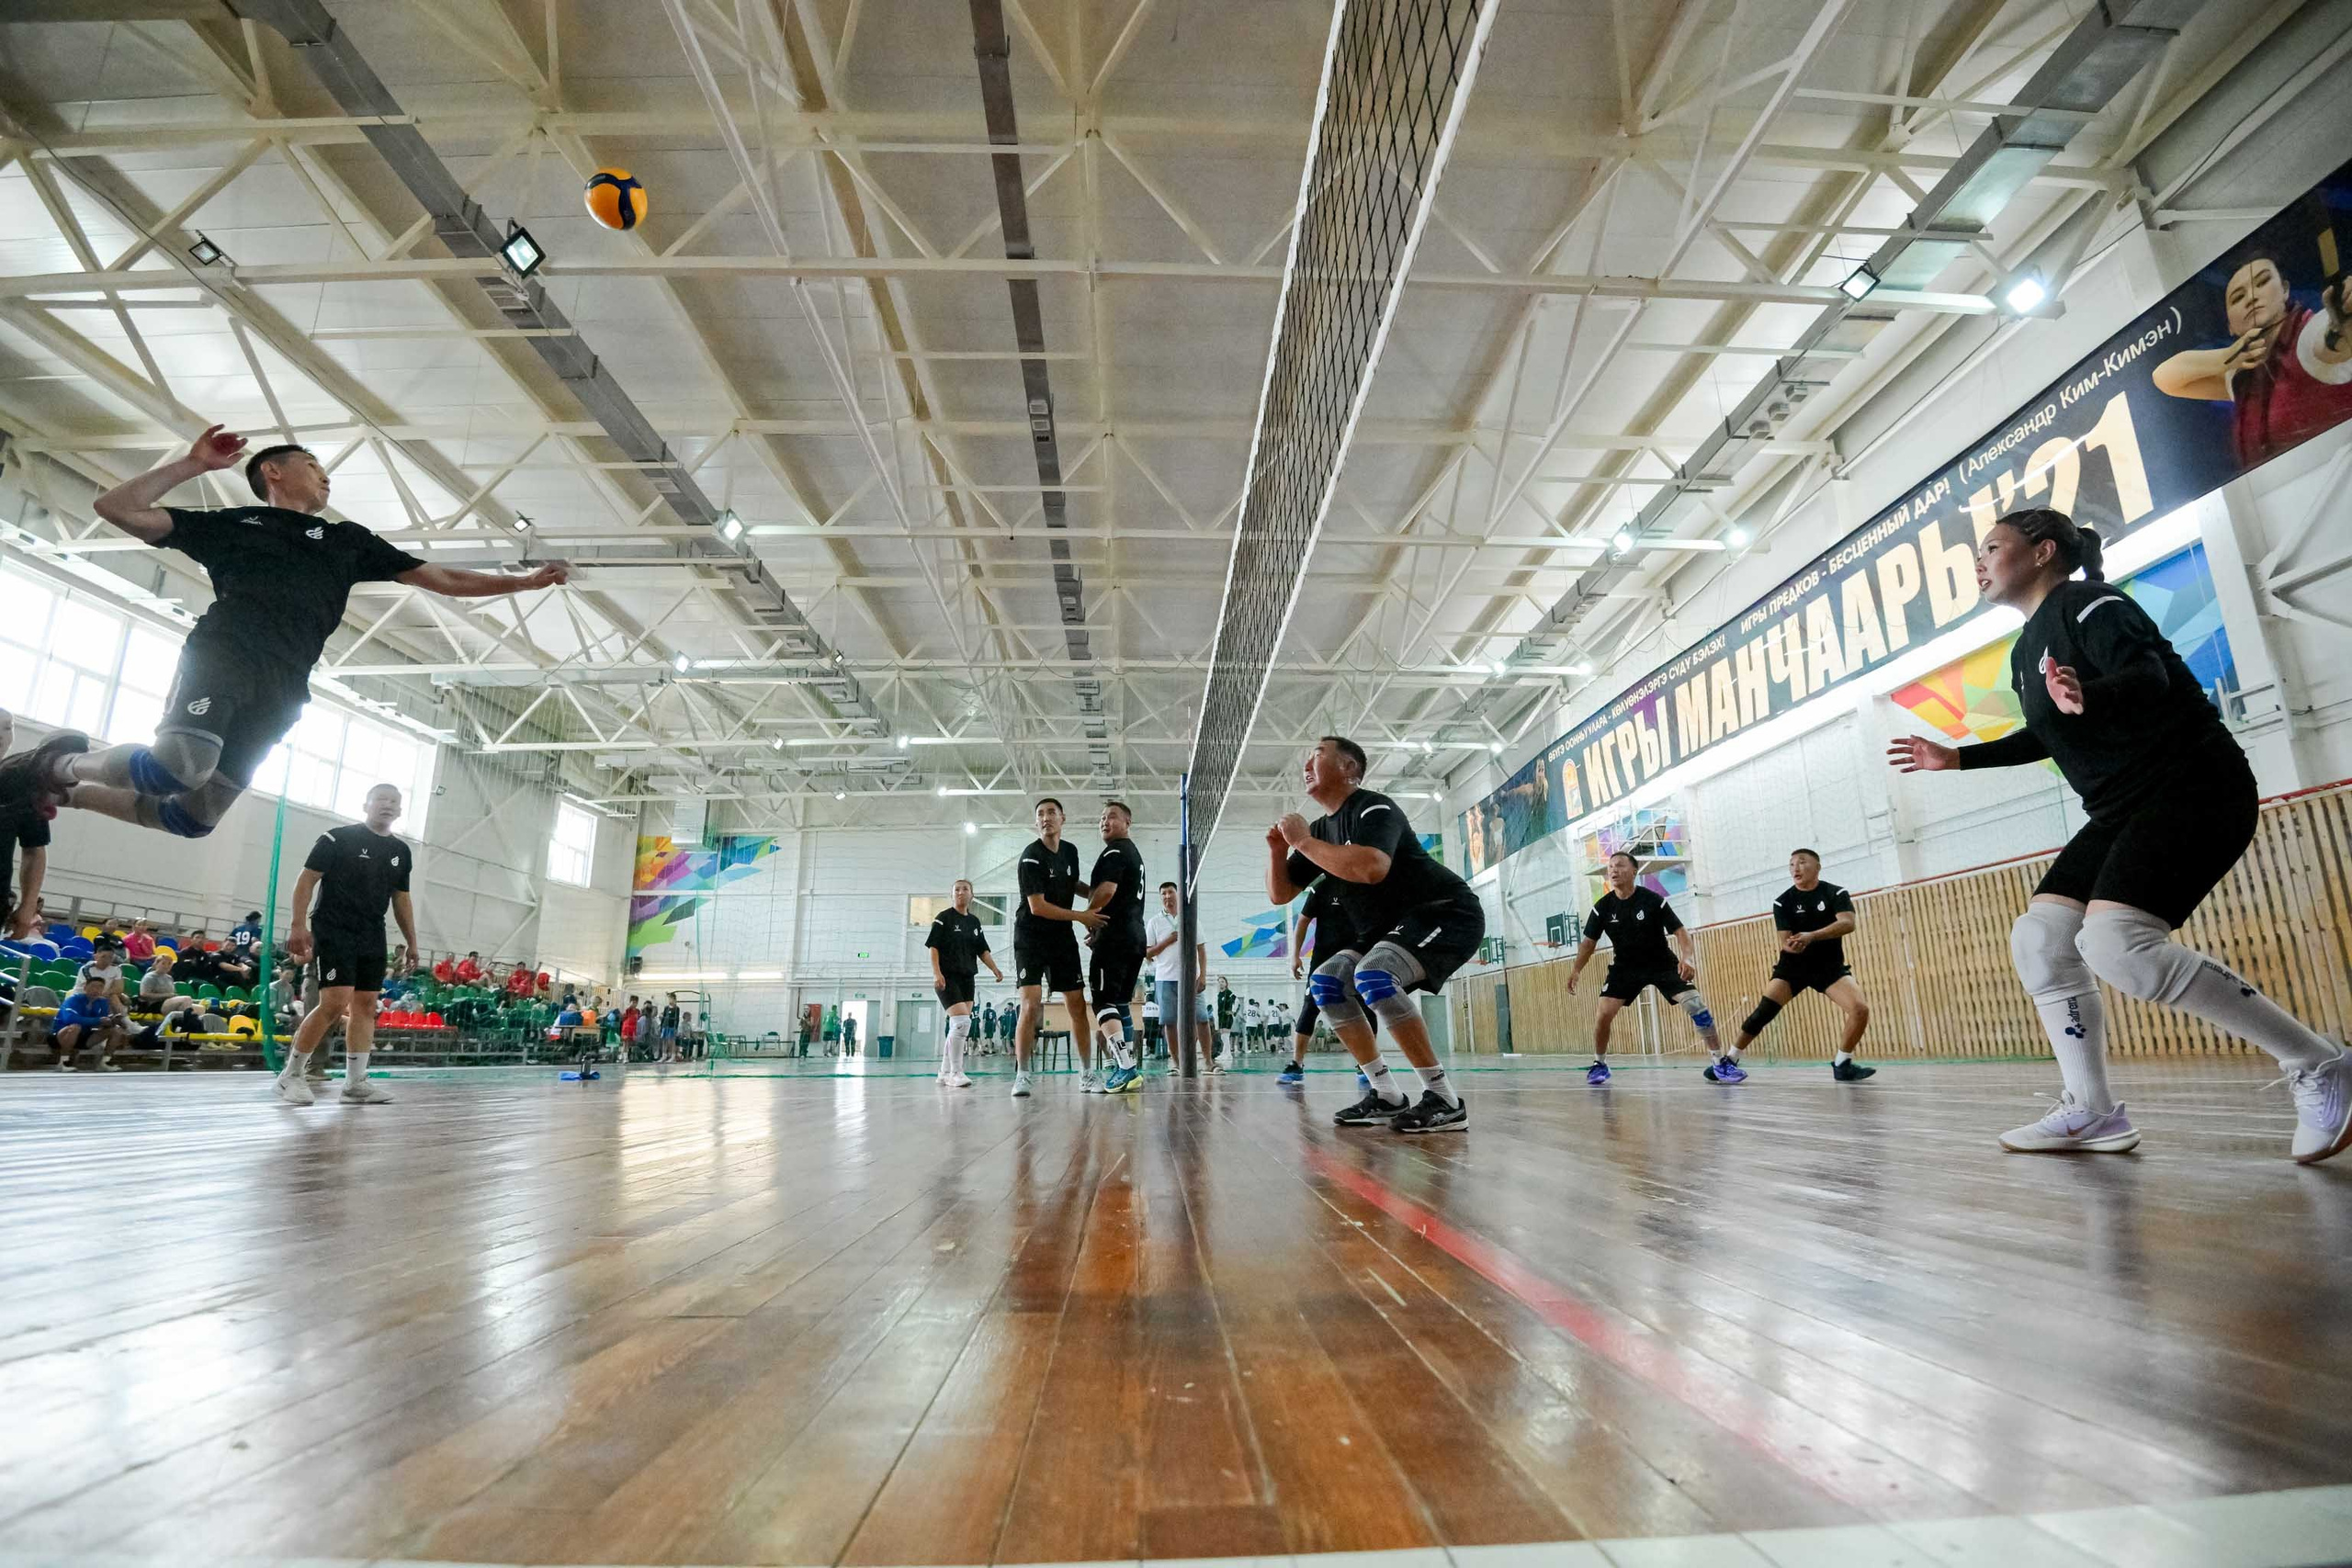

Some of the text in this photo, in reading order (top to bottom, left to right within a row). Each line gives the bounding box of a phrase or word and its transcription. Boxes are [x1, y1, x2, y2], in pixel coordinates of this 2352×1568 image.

[1959, 306, 2182, 485] (Александр Ким-Кимэн)
[1741, 606, 1767, 635] ИГРЫ
[1770, 571, 1820, 615] ПРЕДКОВ
[1829, 503, 1911, 575] БЕСЦЕННЫЙ
[1914, 477, 1951, 520] ДАР!
[1692, 634, 1726, 664] БЭЛЭХ!
[1583, 695, 1672, 808] ИГРЫ
[235, 931, 251, 945] 19
